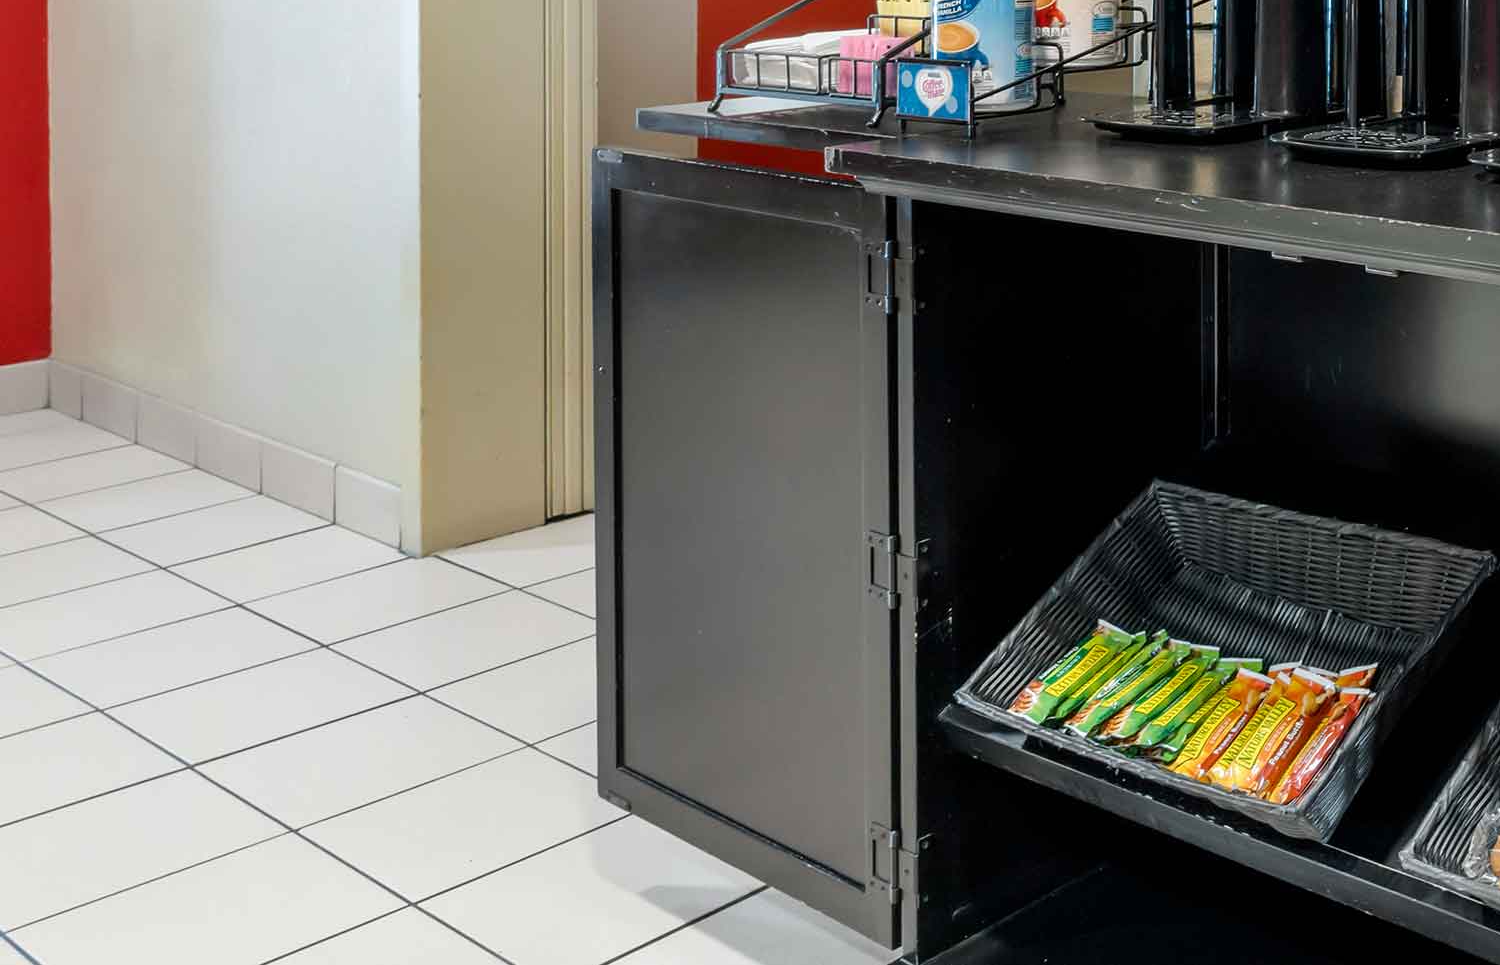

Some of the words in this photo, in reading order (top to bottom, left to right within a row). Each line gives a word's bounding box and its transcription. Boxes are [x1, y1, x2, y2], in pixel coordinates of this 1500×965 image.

[1188, 725, 1212, 756] NATURE
[1208, 698, 1235, 729] VALLEY
[1240, 729, 1267, 766] NATURE
[1262, 700, 1290, 731] VALLEY
